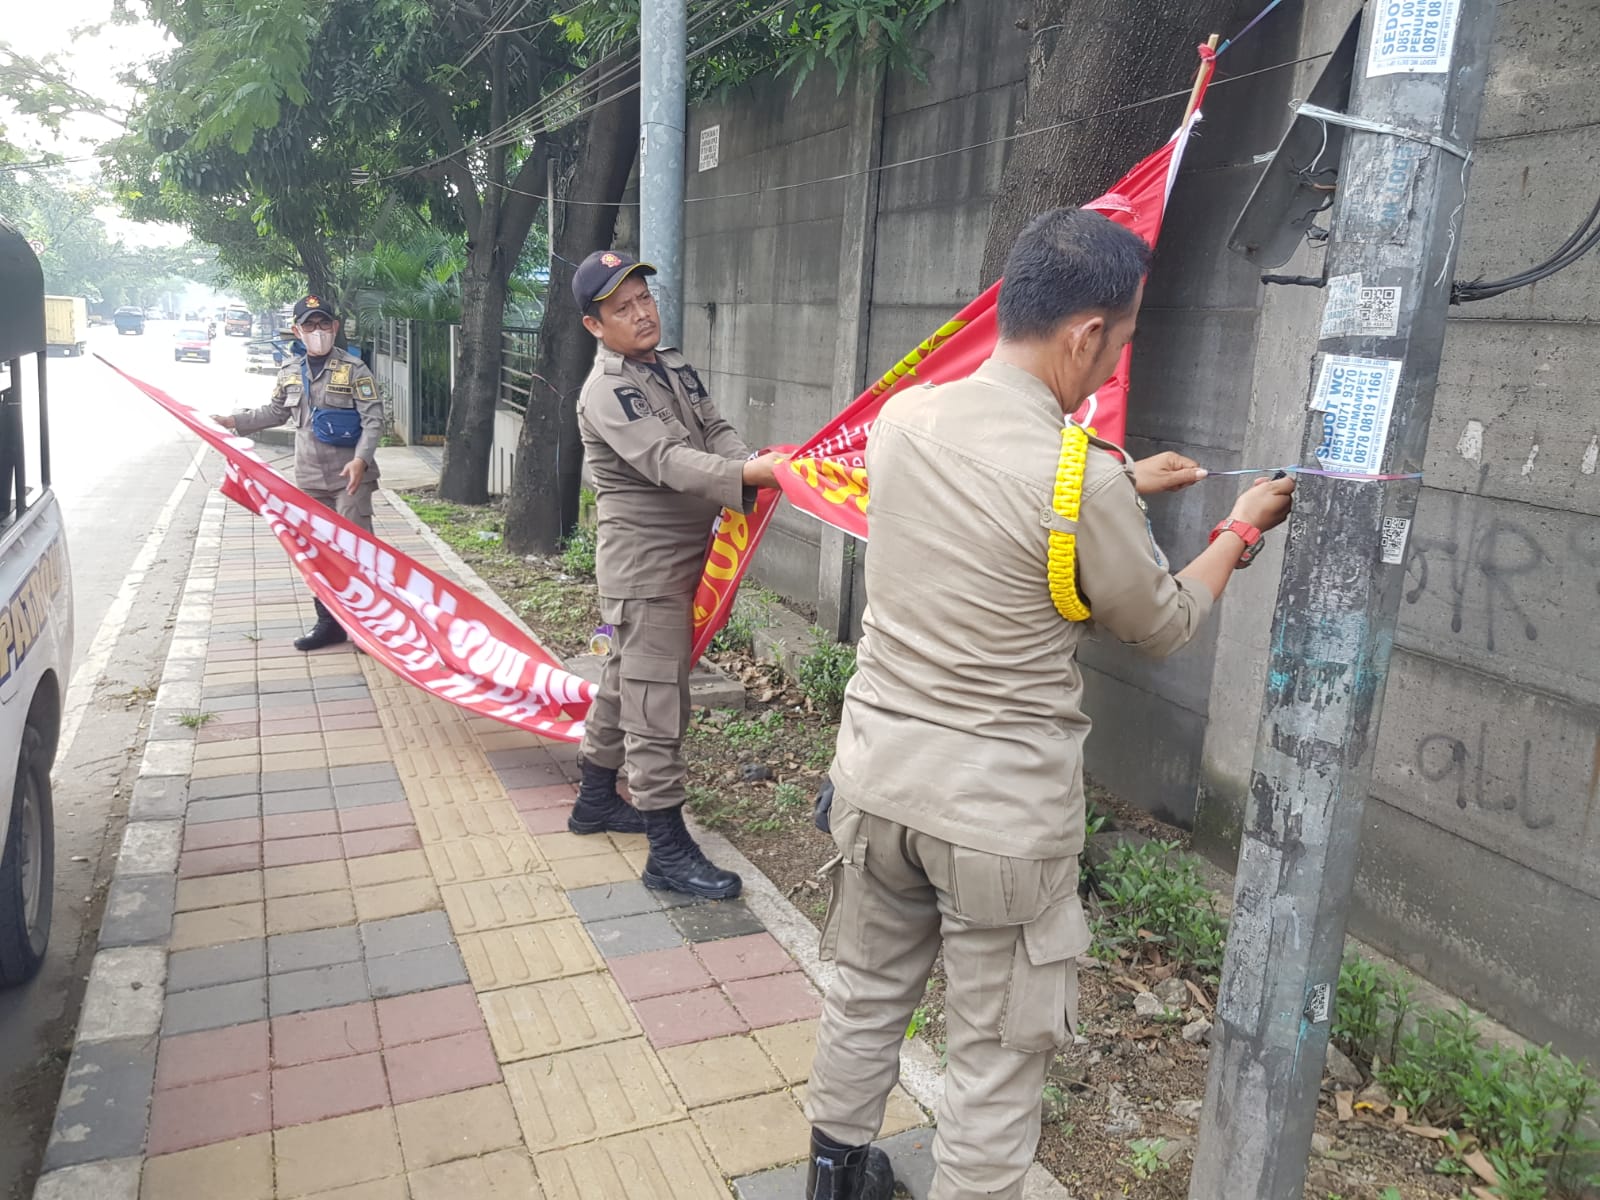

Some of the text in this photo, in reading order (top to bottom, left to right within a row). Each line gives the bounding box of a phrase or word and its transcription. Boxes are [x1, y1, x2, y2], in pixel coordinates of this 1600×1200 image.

[1382, 0, 1400, 55] SEDO
[1396, 0, 1415, 52] 0851 00
[1422, 21, 1438, 52] 0878
[1316, 400, 1338, 458] SEDOT
[1329, 368, 1345, 395] WC
[1331, 370, 1357, 460] 0851 0071 9370
[1342, 371, 1368, 462] PENUH/MAMPET
[1354, 372, 1382, 463] 0878 0819 1166
